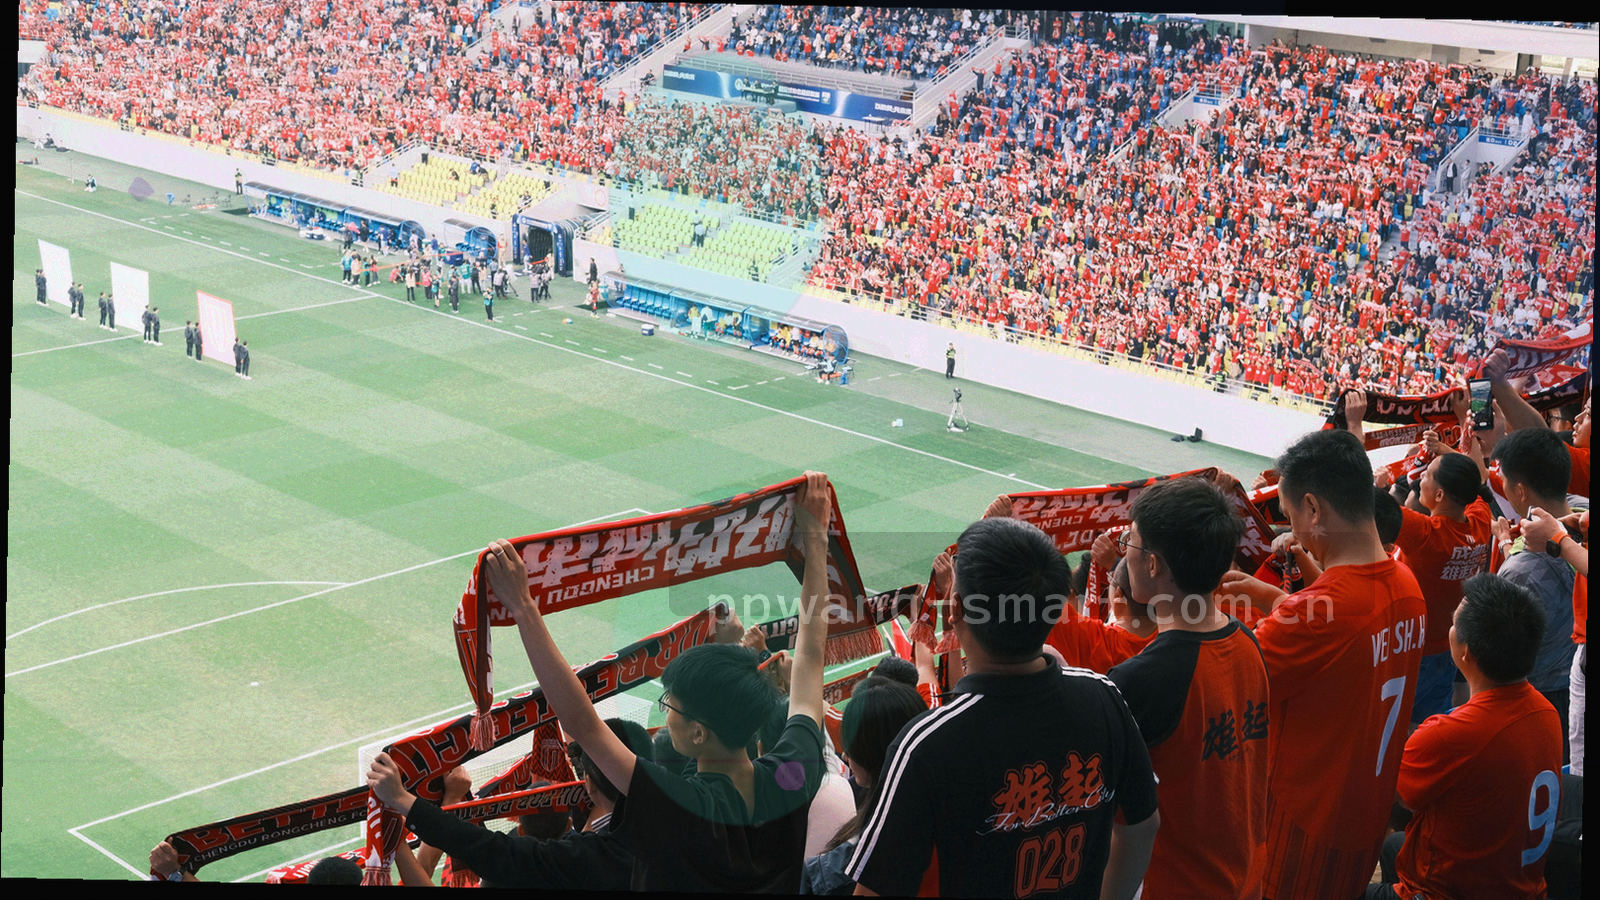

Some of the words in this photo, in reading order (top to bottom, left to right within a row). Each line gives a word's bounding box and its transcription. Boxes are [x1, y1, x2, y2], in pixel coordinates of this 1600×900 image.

[547, 566, 655, 605] CHENGDU
[393, 722, 471, 790] CIT
[1375, 675, 1407, 777] 7
[178, 790, 370, 852] BETTE
[992, 750, 1104, 832] 雄起
[1521, 769, 1560, 868] 9
[194, 837, 257, 863] CHENGDU
[261, 814, 347, 842] RONGCHENG
[1015, 822, 1087, 899] 028
